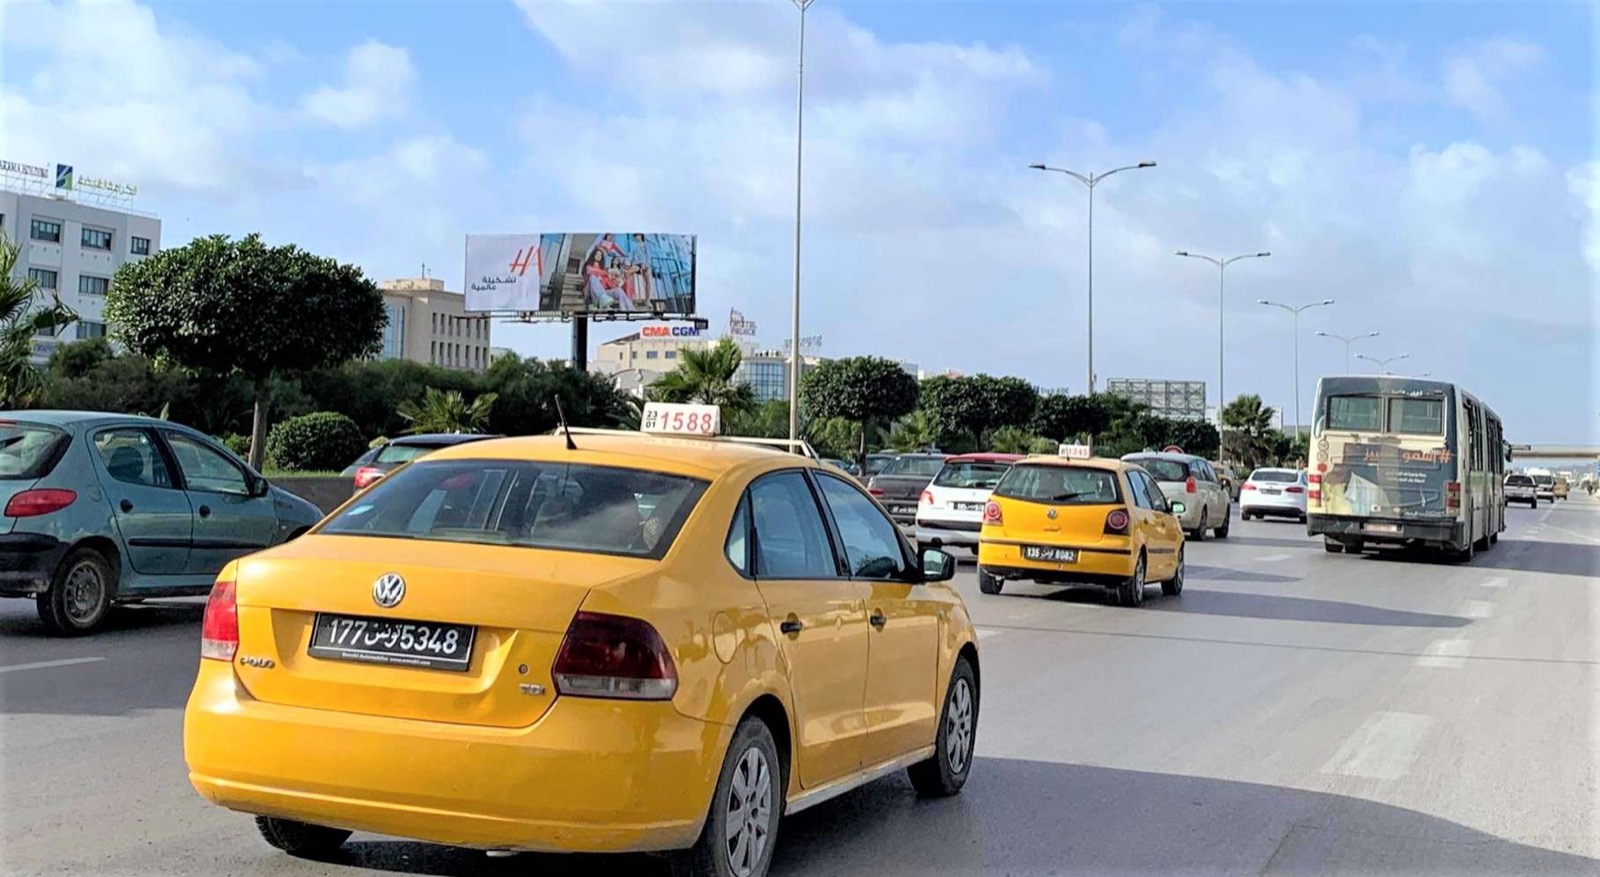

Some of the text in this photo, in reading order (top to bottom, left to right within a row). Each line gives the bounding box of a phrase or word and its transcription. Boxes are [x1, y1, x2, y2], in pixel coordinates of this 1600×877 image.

[642, 327, 700, 337] CMA CGM
[646, 410, 659, 418] 23
[660, 411, 712, 433] 1588
[329, 618, 368, 646] 177
[400, 624, 459, 655] 5348
